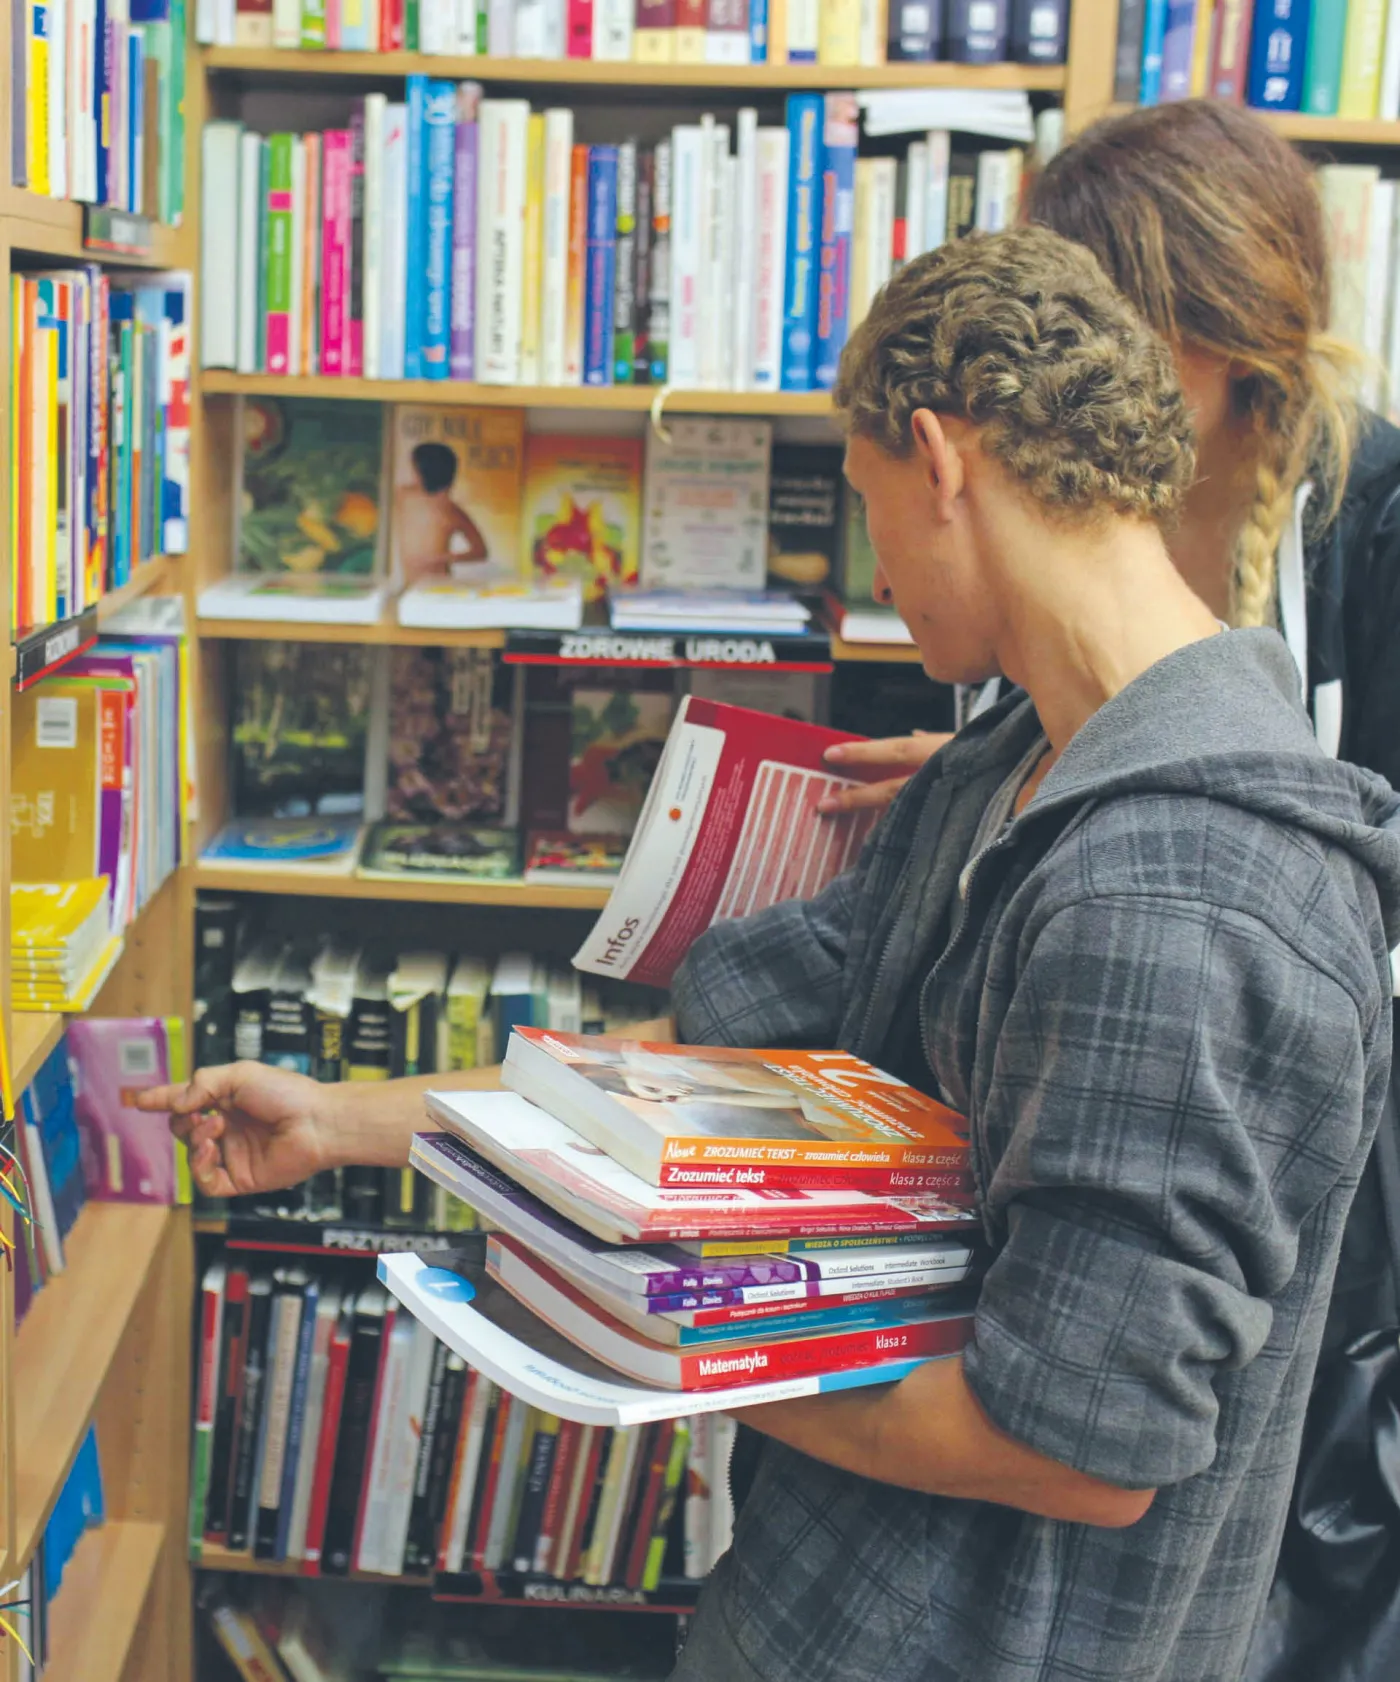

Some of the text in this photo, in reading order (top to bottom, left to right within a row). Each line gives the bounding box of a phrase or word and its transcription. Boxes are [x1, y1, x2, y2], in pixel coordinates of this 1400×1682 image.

[685, 640, 776, 664] URODA
[595, 917, 640, 967] Infos
[763, 1063, 812, 1086] TEKST
[806, 1087, 906, 1138] ZROZUMIEĆ
[703, 1143, 766, 1159] ZROZUMIEĆ
[767, 1147, 796, 1159] TEKST
[804, 1149, 850, 1162] zrozumieć
[850, 1150, 891, 1163] człowieka
[902, 1151, 926, 1164] klasa
[927, 1155, 934, 1164] 2
[936, 1152, 961, 1167] część
[668, 1166, 734, 1184] Zrozumieć
[736, 1168, 766, 1184] tekst
[889, 1172, 915, 1186] klasa
[917, 1176, 924, 1186] 2
[925, 1174, 952, 1188] część
[954, 1177, 960, 1186] 2
[804, 1240, 831, 1250] WIEDZA
[832, 1239, 840, 1248] O
[841, 1236, 898, 1249] SPOŁECZEŃSTWIE
[828, 1264, 849, 1276] Oxford
[850, 1263, 875, 1275] Solutions
[884, 1259, 918, 1271] Intermediate
[919, 1257, 946, 1268] Workbook
[769, 1288, 796, 1299] Solutions
[852, 1279, 885, 1289] Intermediate
[912, 1275, 925, 1285] Book
[843, 1293, 863, 1303] WIEDZA
[699, 1352, 768, 1377] Matematyka
[876, 1335, 900, 1350] klasa
[901, 1335, 907, 1346] 2
